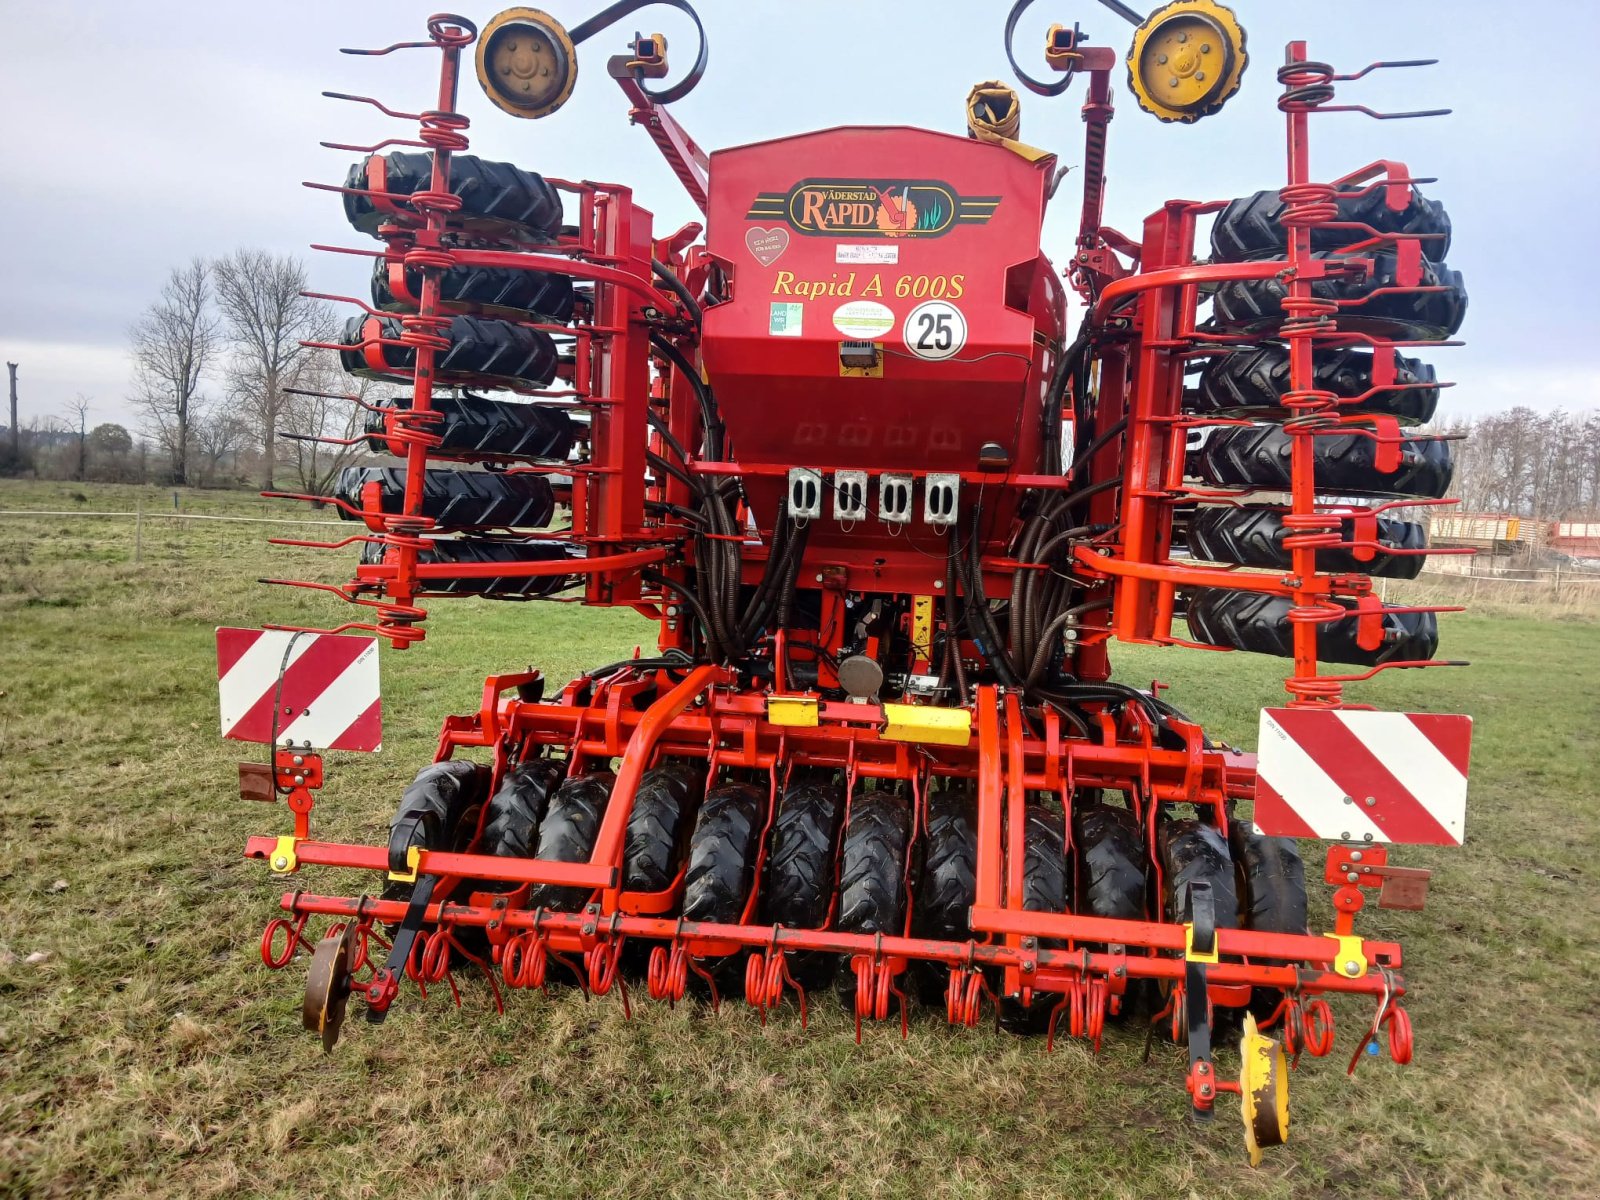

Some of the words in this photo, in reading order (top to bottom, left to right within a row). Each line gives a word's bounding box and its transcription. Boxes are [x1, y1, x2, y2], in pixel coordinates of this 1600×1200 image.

[801, 191, 875, 231] RAPID
[822, 190, 877, 201] VÄDERSTAD
[772, 271, 856, 301] Rapid
[860, 273, 883, 297] A
[895, 274, 965, 300] 600S
[917, 313, 953, 351] 25
